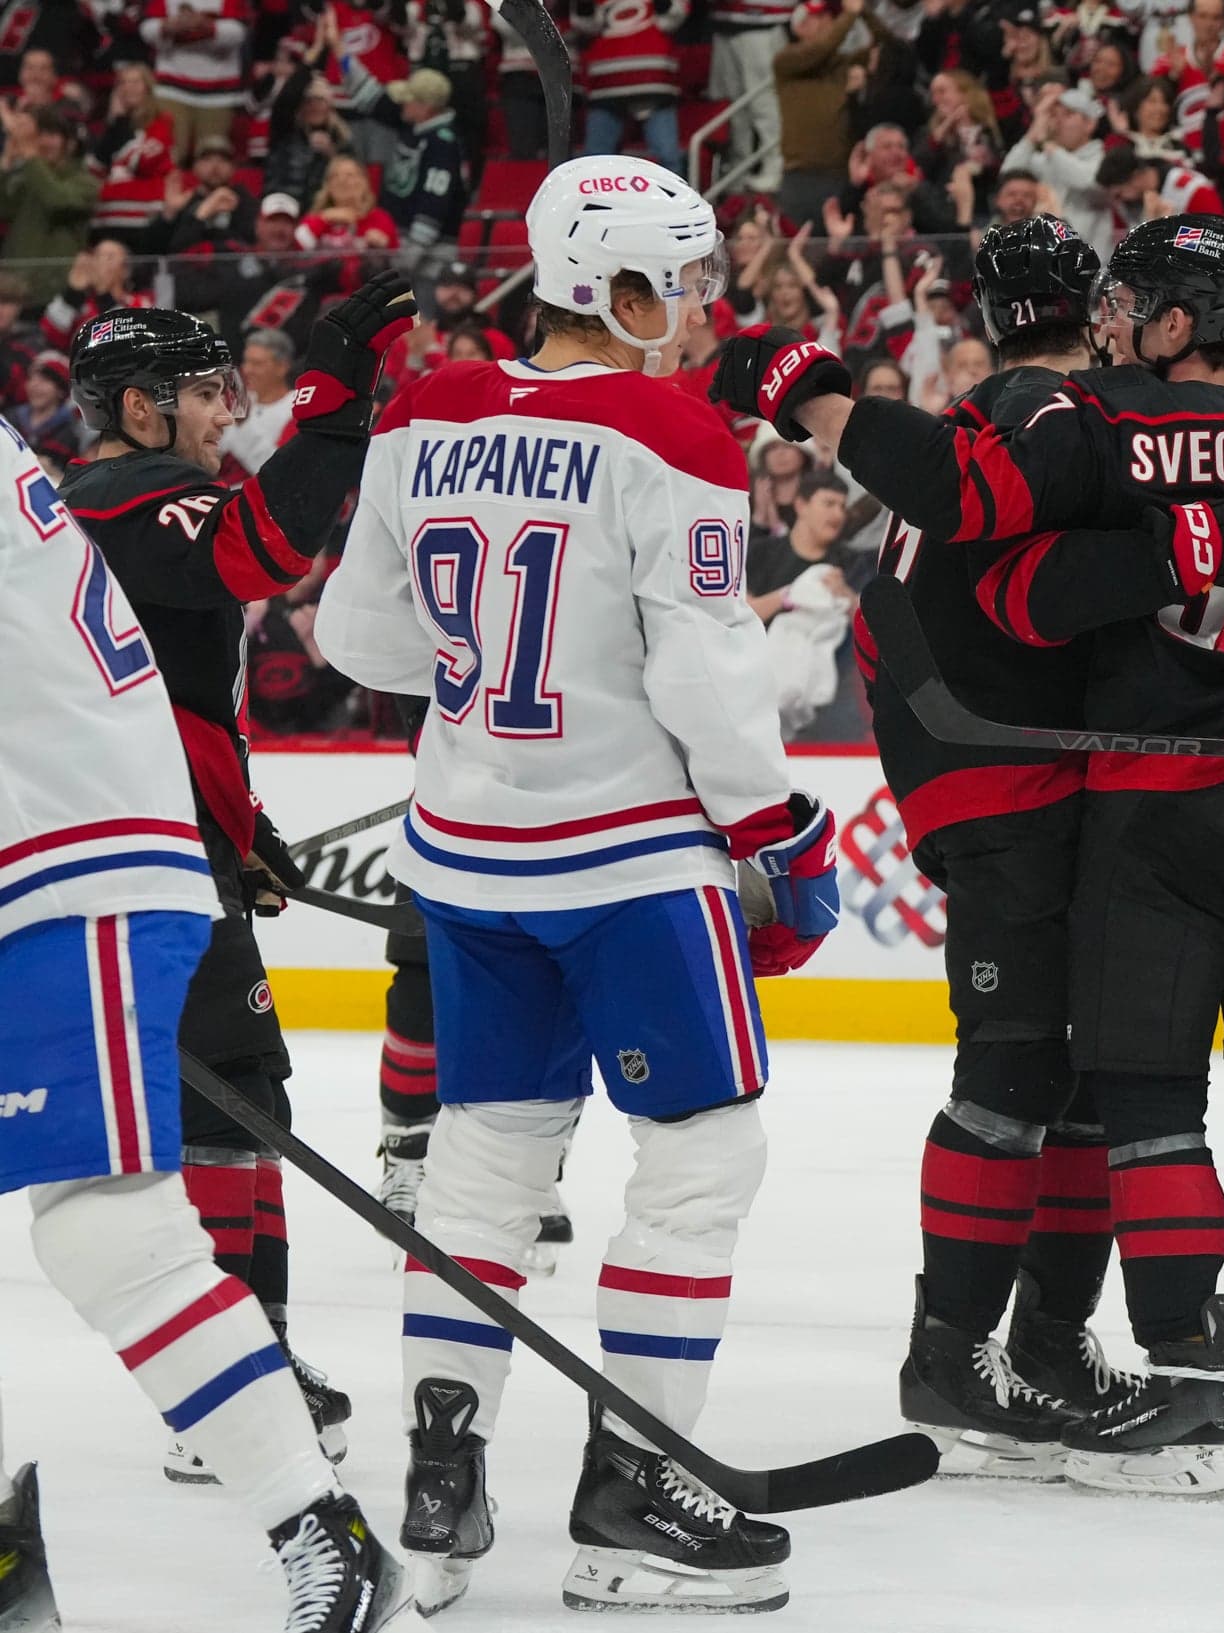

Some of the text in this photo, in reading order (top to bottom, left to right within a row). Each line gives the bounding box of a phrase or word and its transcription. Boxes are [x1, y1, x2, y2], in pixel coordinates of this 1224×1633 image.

[579, 176, 628, 194] CIBC
[1204, 228, 1224, 241] First
[1198, 245, 1221, 259] Bank
[1011, 298, 1036, 326] 21
[411, 434, 600, 504] KAPANEN
[1182, 502, 1214, 576] CC
[411, 516, 570, 739] 91
